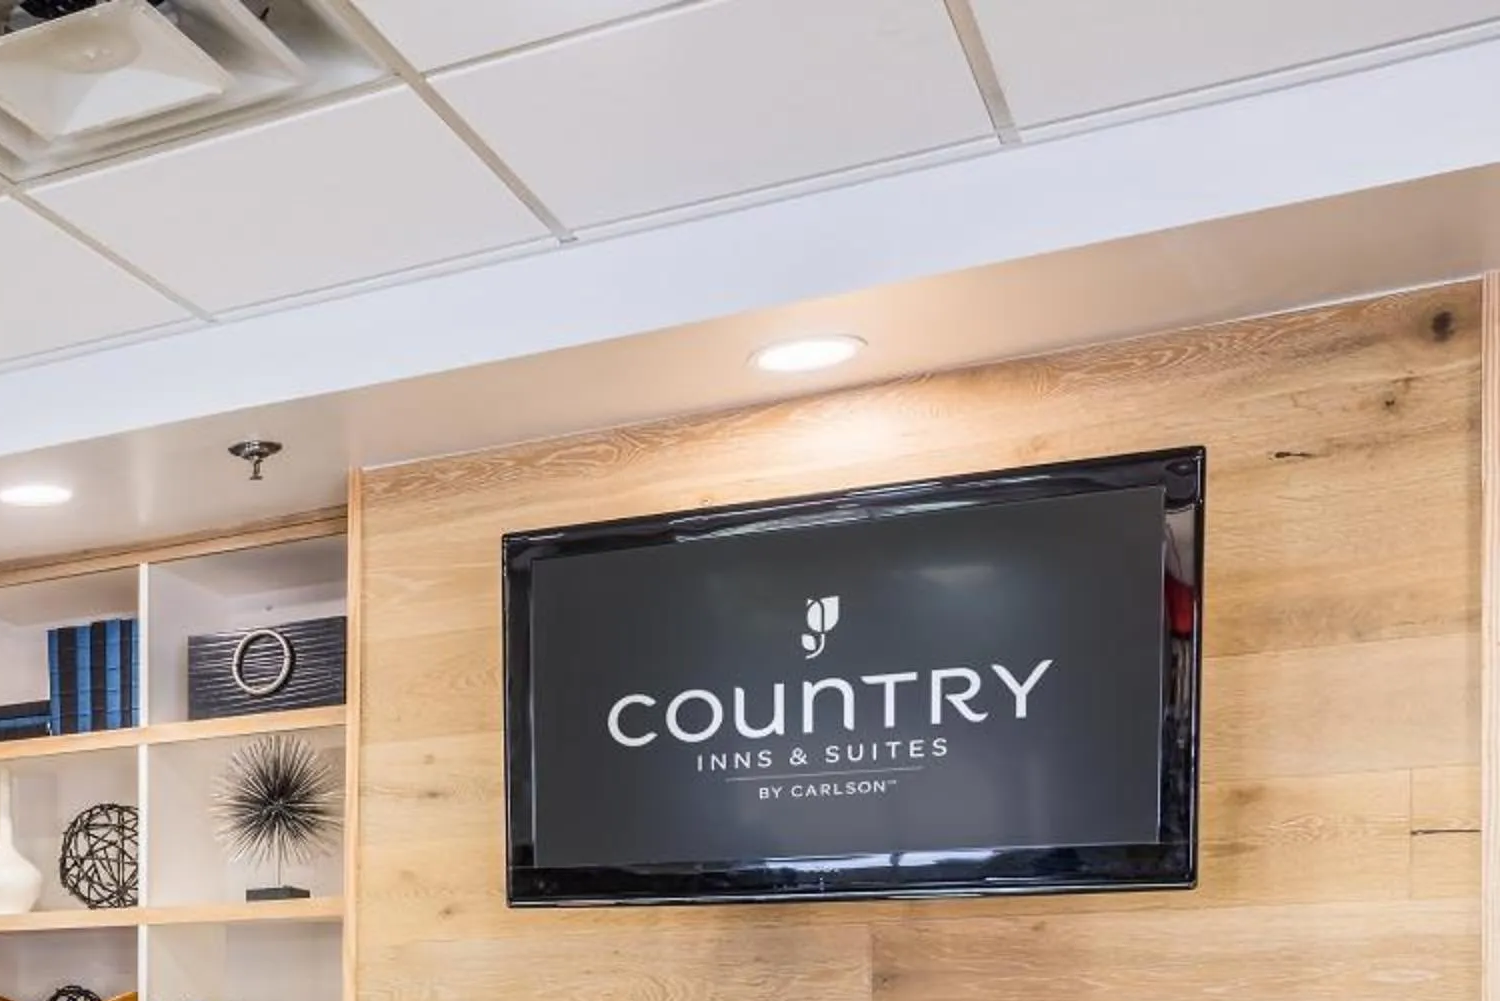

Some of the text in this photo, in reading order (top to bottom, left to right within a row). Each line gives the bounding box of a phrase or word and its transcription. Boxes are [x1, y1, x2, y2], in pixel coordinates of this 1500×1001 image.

[697, 738, 948, 772] INNS & SUITES
[758, 786, 783, 800] BY
